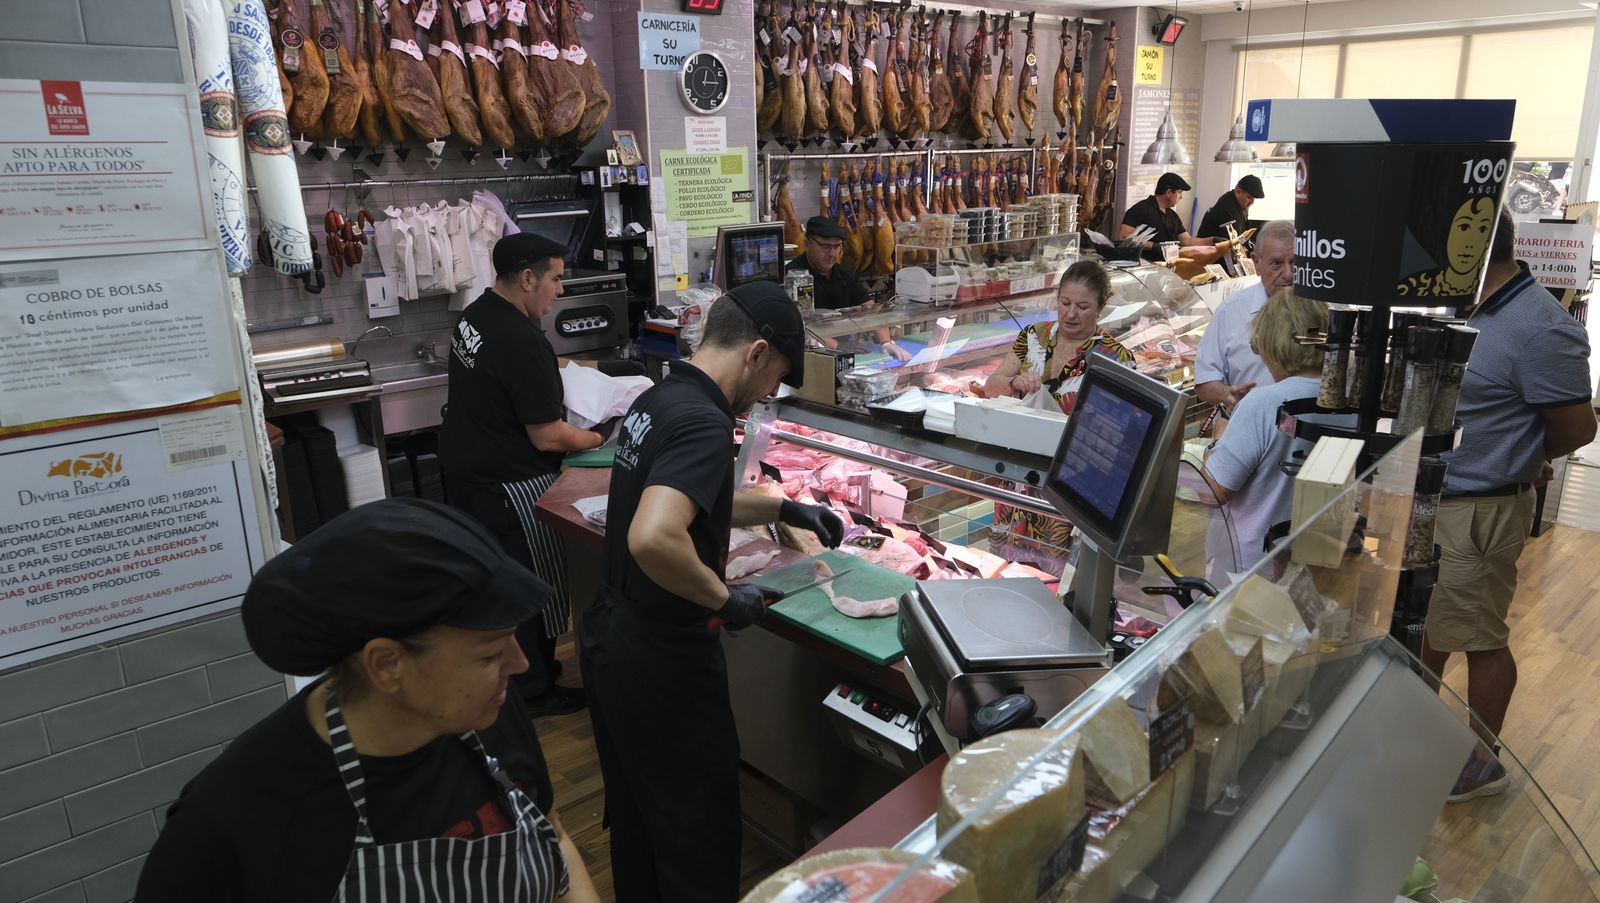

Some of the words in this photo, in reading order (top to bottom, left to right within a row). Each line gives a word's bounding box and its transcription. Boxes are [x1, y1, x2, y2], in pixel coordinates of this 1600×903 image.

[229, 21, 263, 44] DESDE
[642, 19, 696, 32] CARNICERÍA
[663, 39, 677, 50] SU
[718, 67, 724, 76] 2
[717, 92, 723, 100] 4
[1137, 89, 1170, 99] JAMONES
[710, 100, 717, 108] 5
[12, 148, 38, 158] SIN
[43, 144, 133, 158] ALÉRGENOS
[3, 162, 44, 172] APTO
[48, 161, 90, 172] PARA
[686, 156, 717, 164] ECOLÓGICA
[673, 168, 711, 176] CERTIFICADA
[1462, 159, 1507, 184] 100
[1468, 185, 1496, 194] AÑOS
[1554, 240, 1584, 248] FERIA
[1542, 264, 1576, 273] 14:00h
[1535, 276, 1576, 285] CERRADO
[26, 290, 81, 304] COBRO
[87, 288, 105, 299] DE
[110, 282, 163, 296] BOLSAS
[39, 308, 98, 321] céntimos
[103, 306, 123, 318] por
[128, 300, 169, 313] unidad
[18, 489, 69, 506] Divina
[43, 514, 66, 526] DEL
[68, 499, 145, 521] REGLAMENTO
[148, 494, 169, 505] (UE)
[172, 485, 217, 500] 1169/2011
[78, 510, 149, 532] ALIMENTARIA
[151, 497, 208, 517] FACILITADA
[210, 494, 223, 505] AL
[42, 539, 72, 552] ESTE
[75, 517, 175, 546] ESTABLECIMIENTO
[177, 511, 207, 524] TIENE
[19, 556, 50, 571] PARA
[52, 552, 68, 564] SU
[71, 539, 130, 559] CONSULTA
[132, 536, 145, 546] LA
[147, 520, 219, 543] INFORMACIÓN
[21, 574, 30, 583] A
[32, 570, 46, 581] LA
[48, 555, 113, 577] PRESENCIA
[115, 551, 130, 562] DE
[133, 536, 198, 558] ALERGENOS
[201, 534, 207, 542] Y
[28, 581, 54, 594] QUE
[57, 566, 120, 588] PROVOCAN
[123, 546, 207, 572] INTOLERANCIAS
[210, 542, 224, 552] DE
[26, 585, 89, 607] NUESTROS
[92, 568, 163, 591] PRODUCTOS.
[9, 616, 56, 634] NUESTRO
[58, 603, 108, 622] PERSONAL
[111, 600, 119, 609] SI
[122, 592, 152, 606] DESEA
[153, 588, 172, 599] MAS
[174, 573, 232, 594] INFORMACIÓN
[60, 617, 101, 632] MUCHAS
